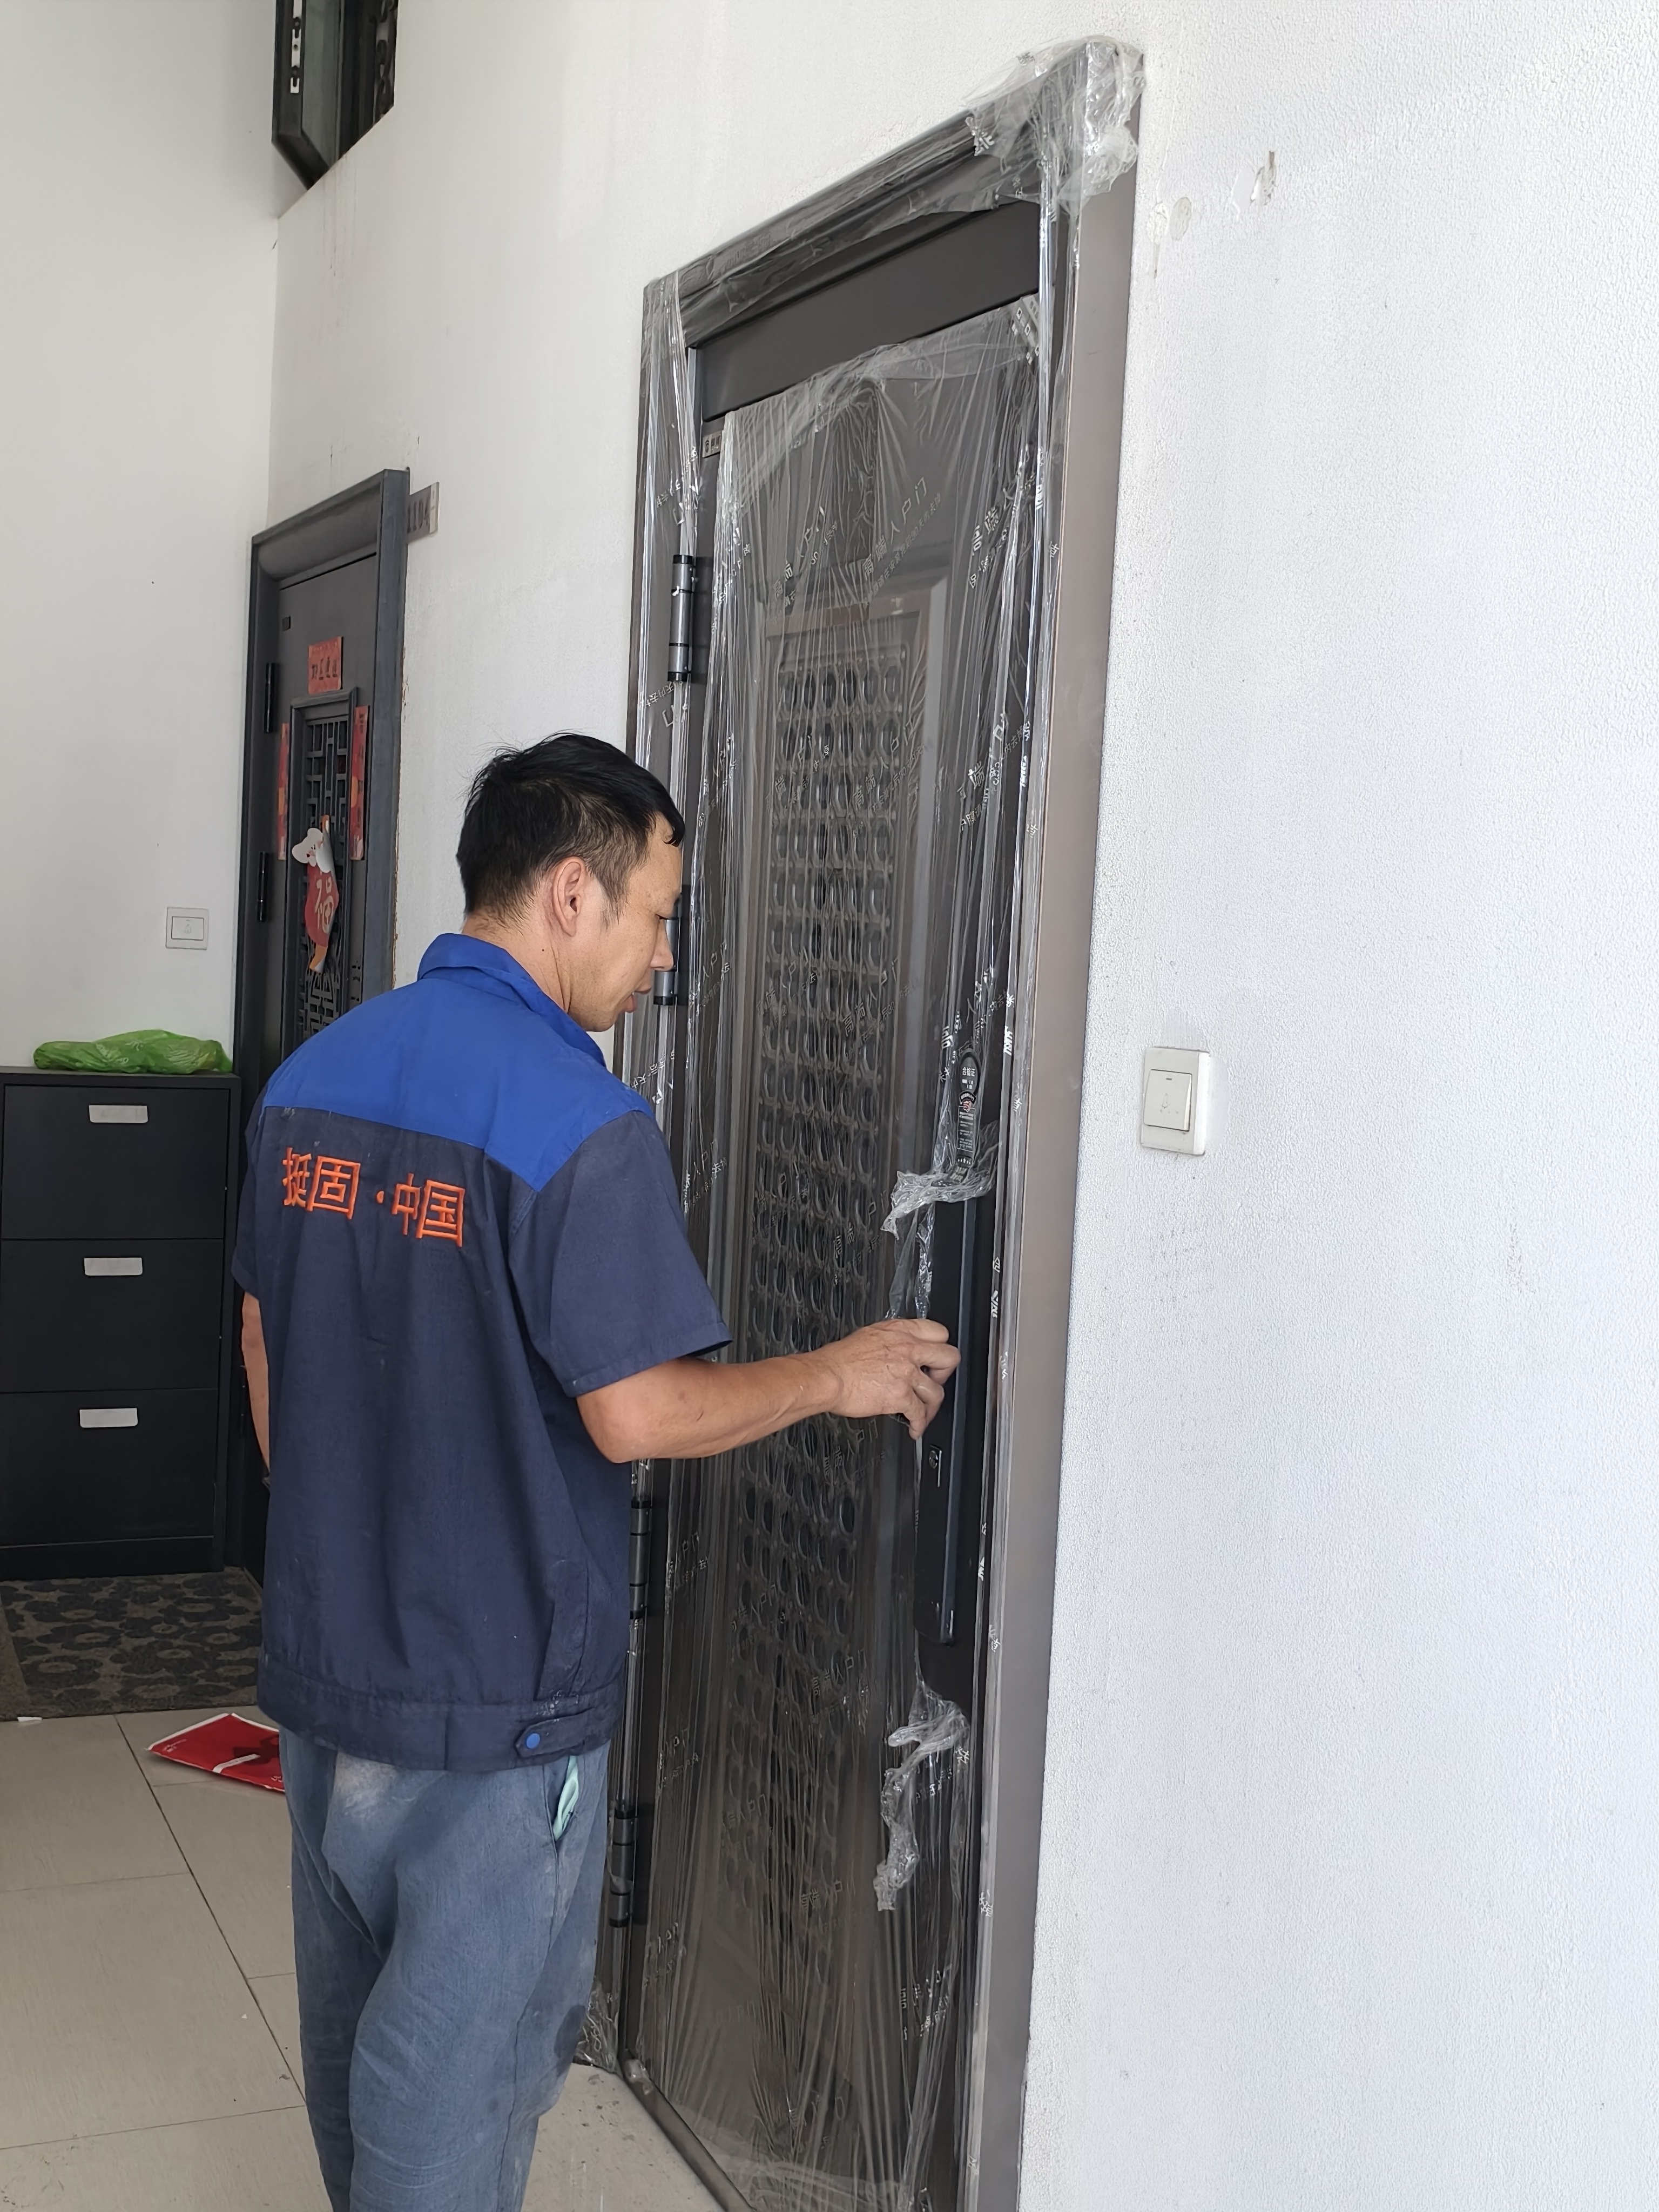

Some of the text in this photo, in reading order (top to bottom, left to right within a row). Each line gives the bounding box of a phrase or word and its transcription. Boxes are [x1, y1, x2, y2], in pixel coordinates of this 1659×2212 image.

[862, 476, 927, 582] 高端入户门
[962, 1066, 976, 1077] 合格证
